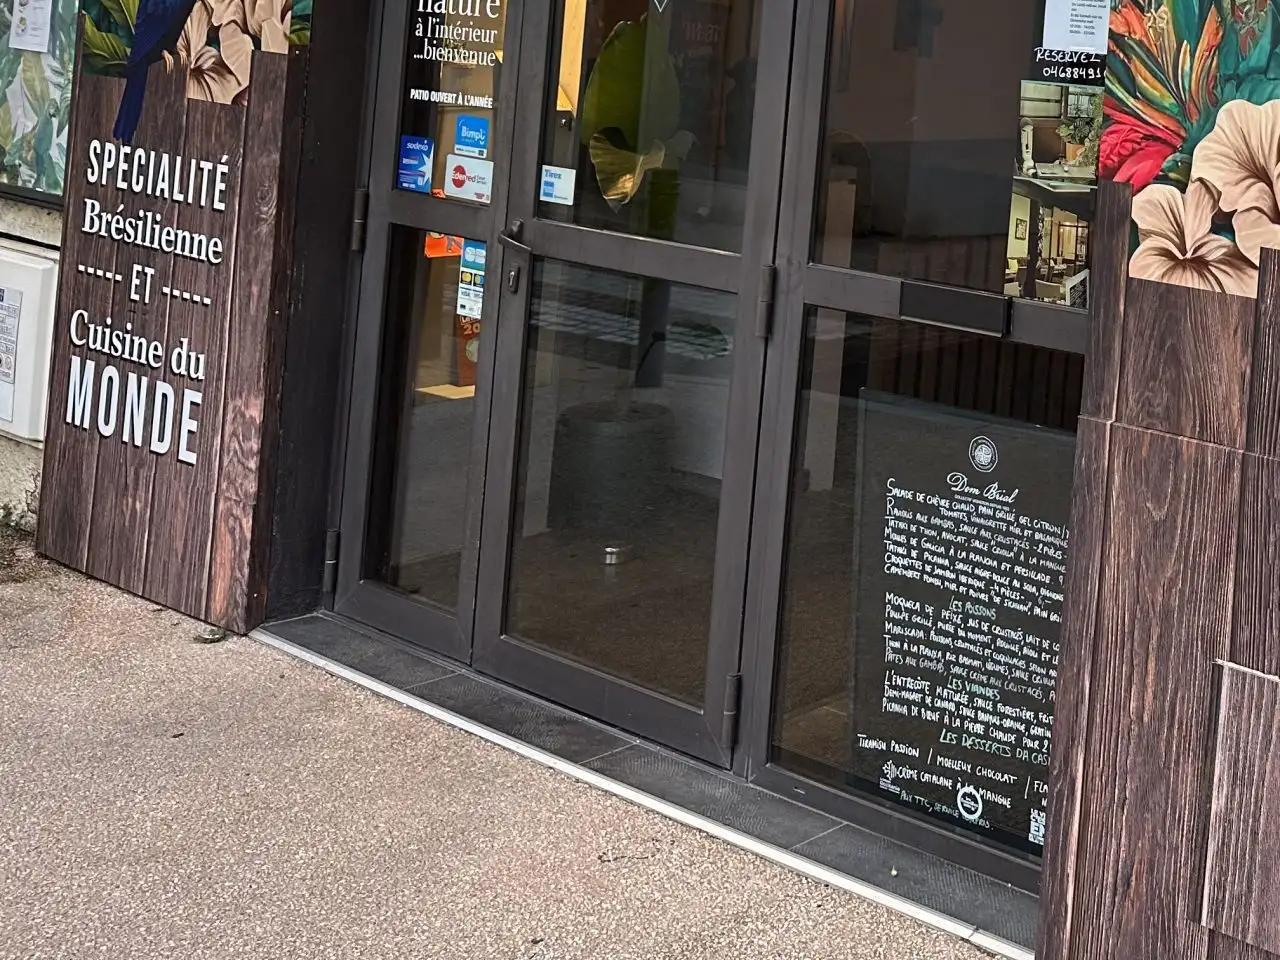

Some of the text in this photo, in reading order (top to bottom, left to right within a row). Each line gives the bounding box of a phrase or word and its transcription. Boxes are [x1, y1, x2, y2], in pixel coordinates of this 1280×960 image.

[415, 16, 498, 44] à l'intérieur
[413, 37, 496, 67] ...bienvenue
[1034, 47, 1101, 64] RESERVEZ
[410, 88, 494, 109] PATIO OUVERT À L'ANNÉE
[406, 140, 429, 151] sodexo
[86, 139, 229, 211] SPECIALITÉ
[452, 168, 477, 184] Edenred
[82, 198, 223, 263] Brésilienne
[130, 264, 155, 304] ET
[70, 309, 163, 368] Cuisine
[171, 338, 205, 380] du
[66, 355, 202, 465] MONDE
[946, 472, 1018, 503] Dom Brial
[886, 477, 914, 500] SALADE
[916, 492, 925, 502] DE
[978, 505, 993, 516] PAIN
[1018, 515, 1031, 526] GEL
[1033, 519, 1060, 534] CITRON
[941, 531, 967, 546] AVOCAT,
[910, 548, 918, 559] DE
[910, 537, 918, 546] DE
[1000, 562, 1011, 571] ET
[885, 591, 920, 613] MOQUECA
[924, 604, 934, 616] DE
[981, 621, 989, 632] DE
[948, 595, 962, 612] LES
[1041, 652, 1050, 661] ET
[947, 675, 1000, 700] LES VIANDES
[939, 728, 958, 744] LES
[989, 726, 1016, 744] CHAUDE
[890, 739, 919, 757] PASSION
[976, 765, 1017, 783] CHOCOLAT
[920, 771, 952, 789] CATALANE
[977, 787, 1011, 808] MANGUE
